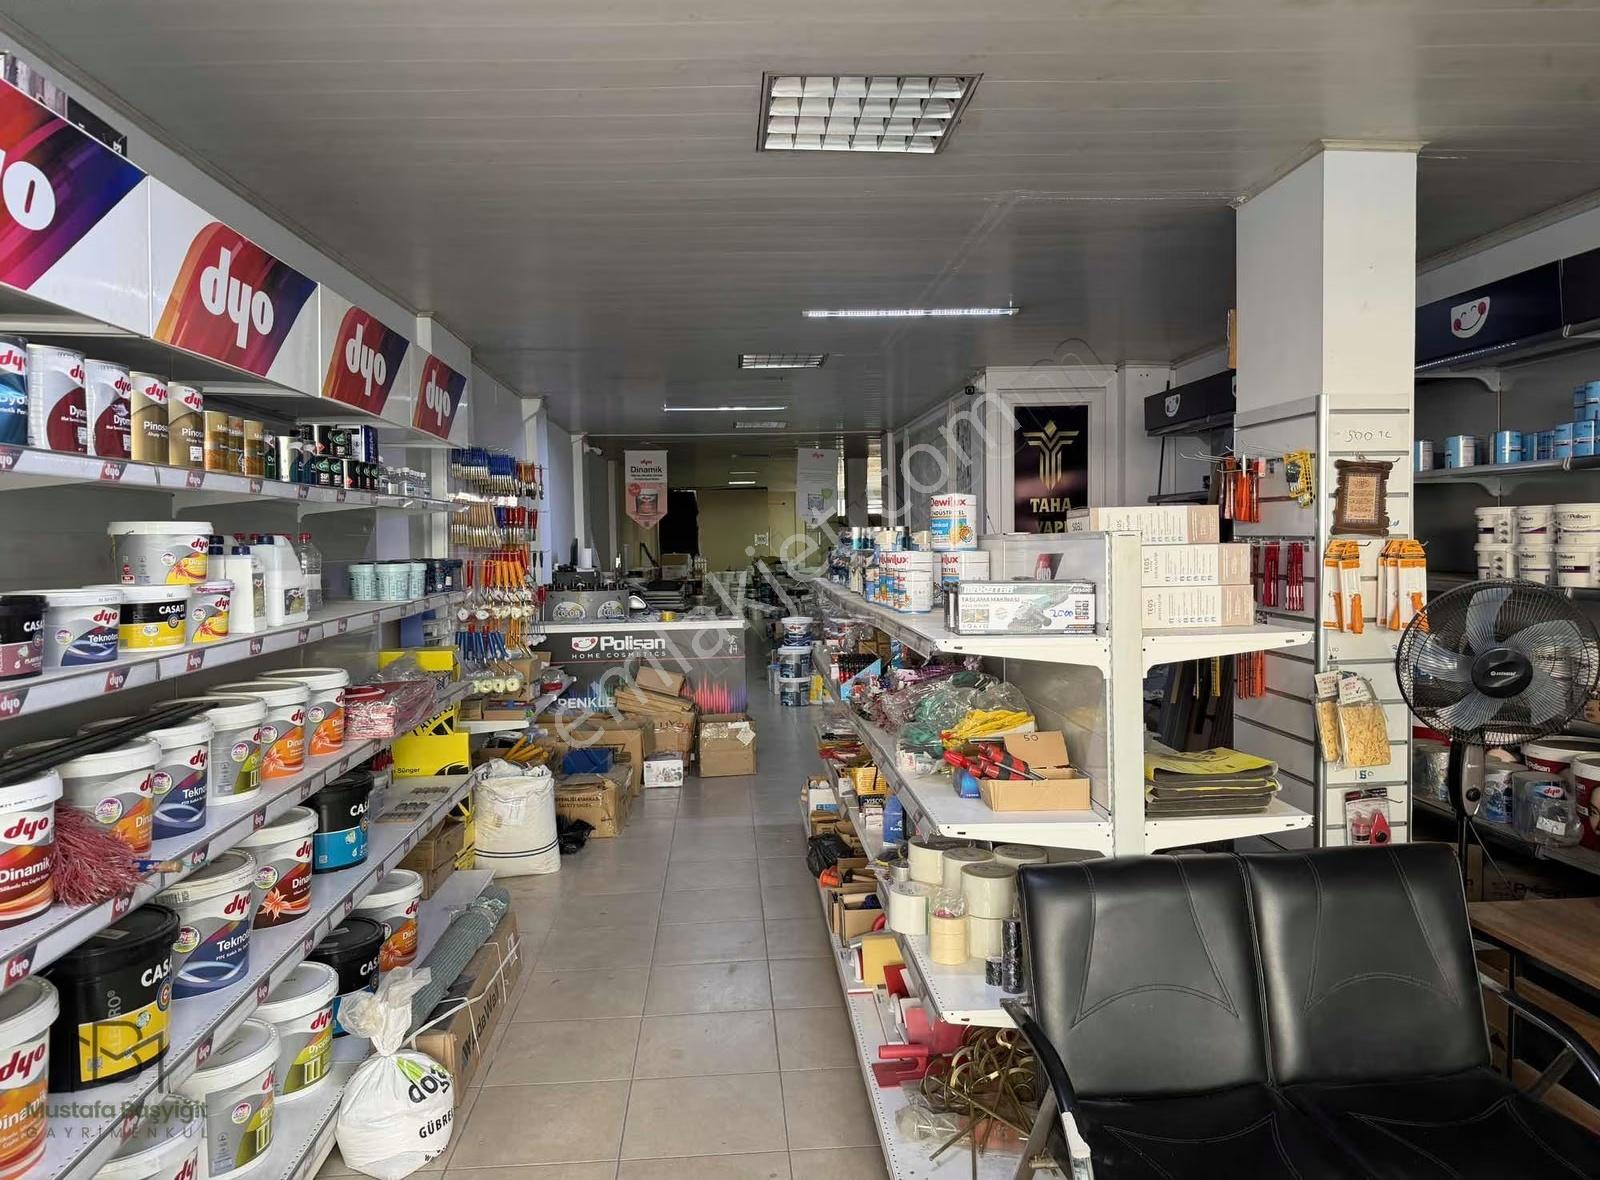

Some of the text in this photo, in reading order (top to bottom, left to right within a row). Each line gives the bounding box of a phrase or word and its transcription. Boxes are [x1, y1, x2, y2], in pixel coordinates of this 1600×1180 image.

[200, 247, 275, 349] dyo
[345, 323, 387, 397] dyo
[425, 369, 451, 427] dyo
[631, 466, 663, 474] Dinamik
[1030, 498, 1072, 513] TAHA
[93, 610, 118, 624] dyo
[600, 636, 666, 651] Polisan
[606, 650, 667, 658] COSMETICS
[109, 673, 124, 688] dyo
[1, 697, 20, 714] dyo
[4, 817, 49, 841] dyo
[115, 897, 130, 912] dyo
[9, 958, 29, 976] dyo
[0, 1043, 45, 1083] dyo
